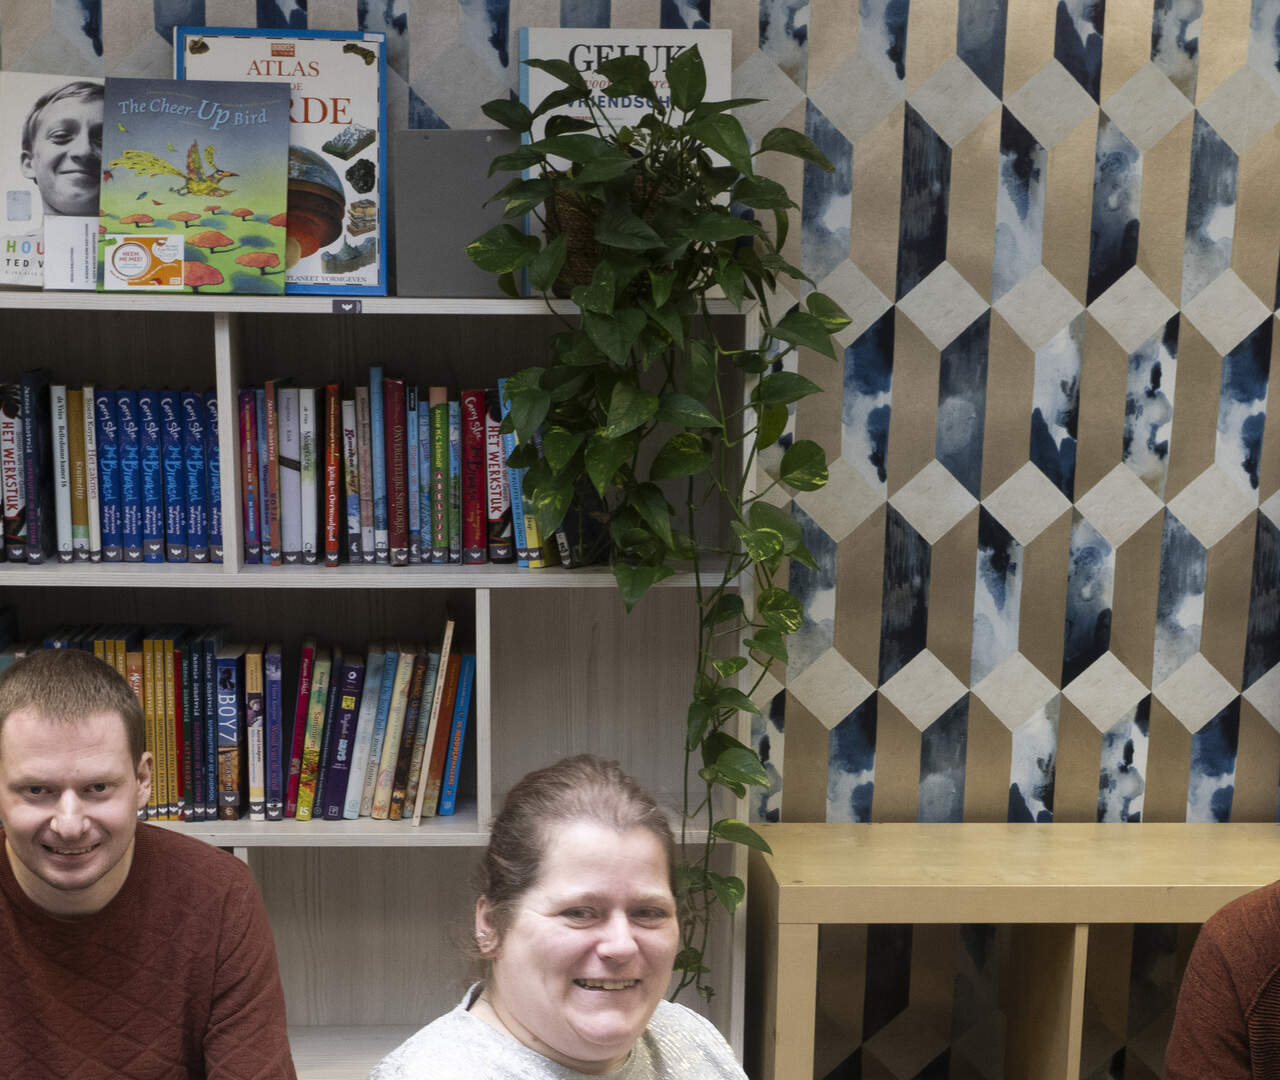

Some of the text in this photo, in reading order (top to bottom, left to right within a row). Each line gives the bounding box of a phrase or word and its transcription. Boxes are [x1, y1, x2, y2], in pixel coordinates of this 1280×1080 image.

[247, 60, 320, 77] ATLAS
[119, 98, 146, 114] The
[234, 108, 268, 126] Bird
[6, 259, 29, 267] TED
[2, 422, 17, 512] HET WERKSTUK
[488, 426, 502, 514] HET WERKSTUK
